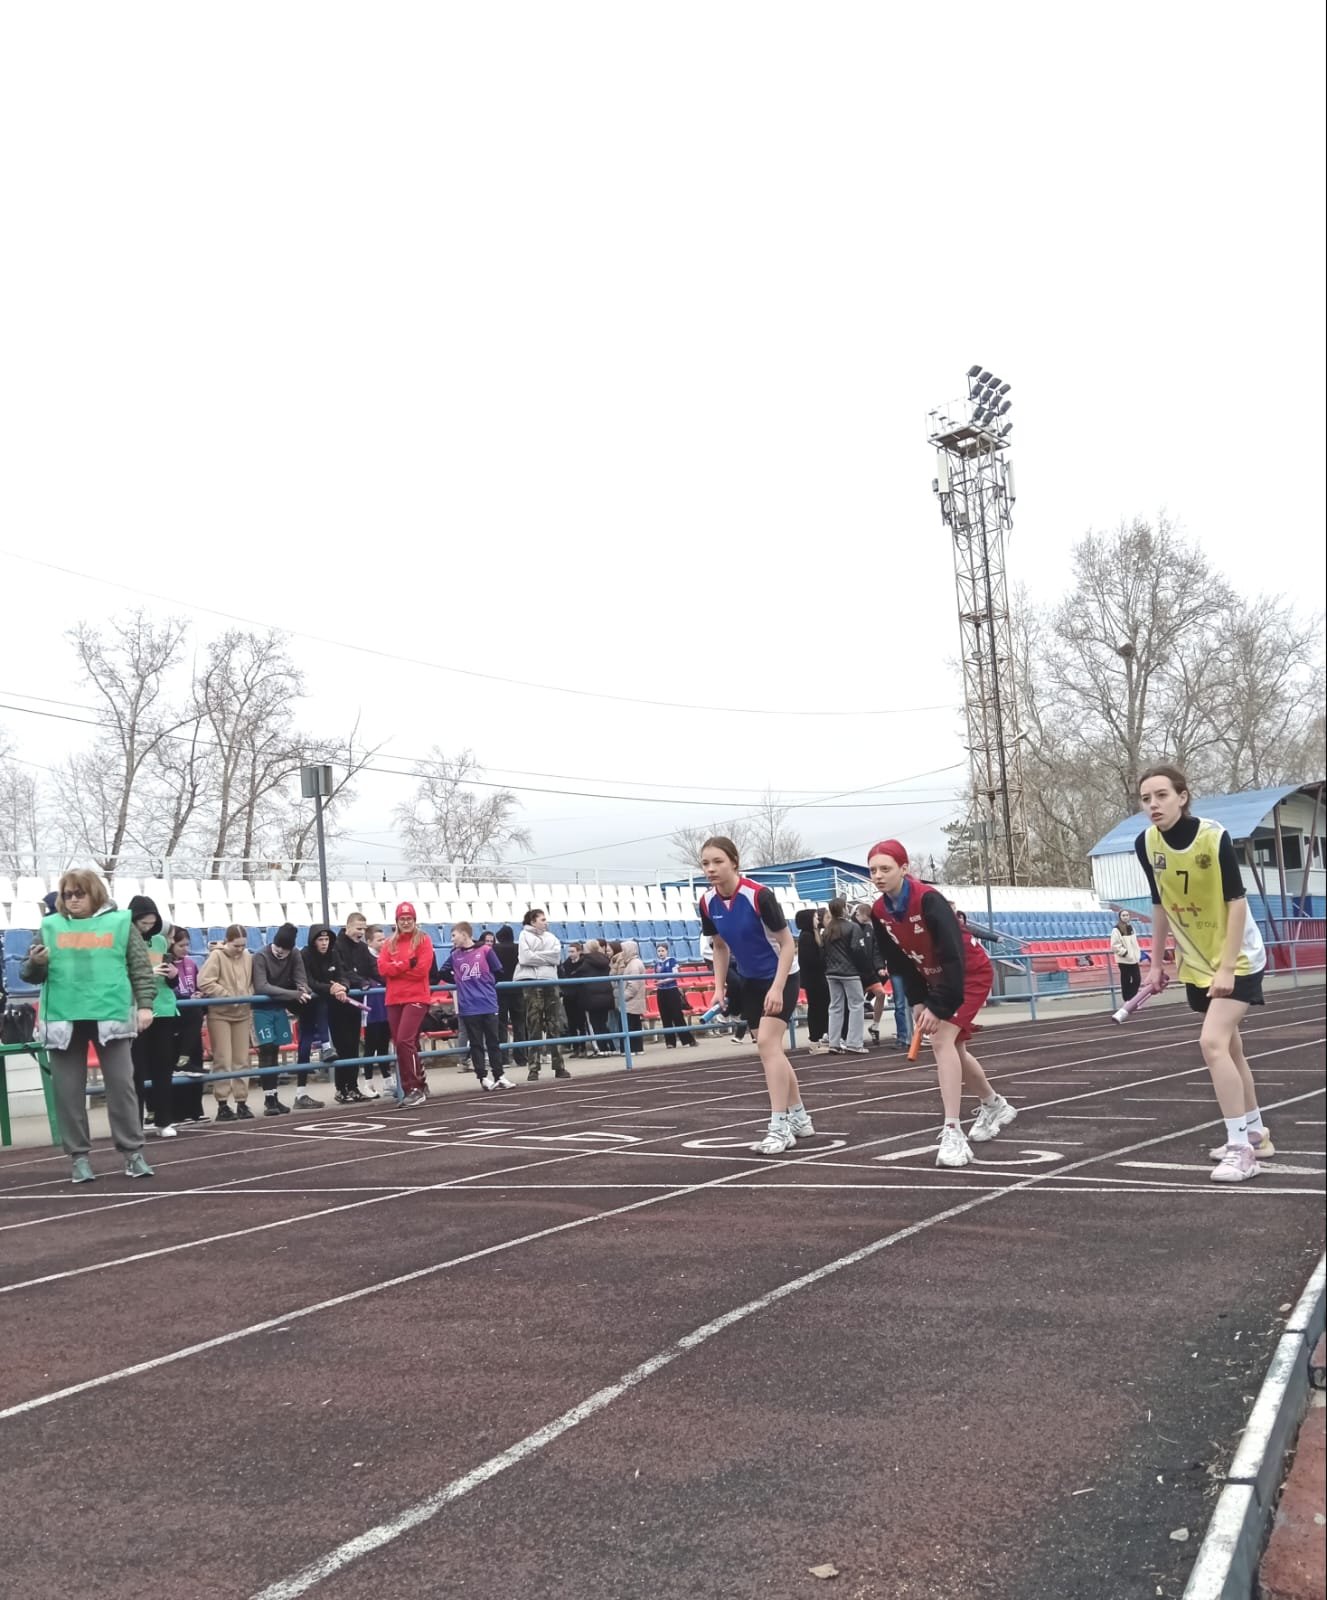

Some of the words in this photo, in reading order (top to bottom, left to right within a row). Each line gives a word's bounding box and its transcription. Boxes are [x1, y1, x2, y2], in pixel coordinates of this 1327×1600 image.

[1176, 870, 1189, 895] 7
[459, 961, 482, 982] 24
[258, 1028, 272, 1040] 13
[293, 1121, 387, 1134] 6
[407, 1126, 516, 1138] 5
[512, 1131, 644, 1143] 4
